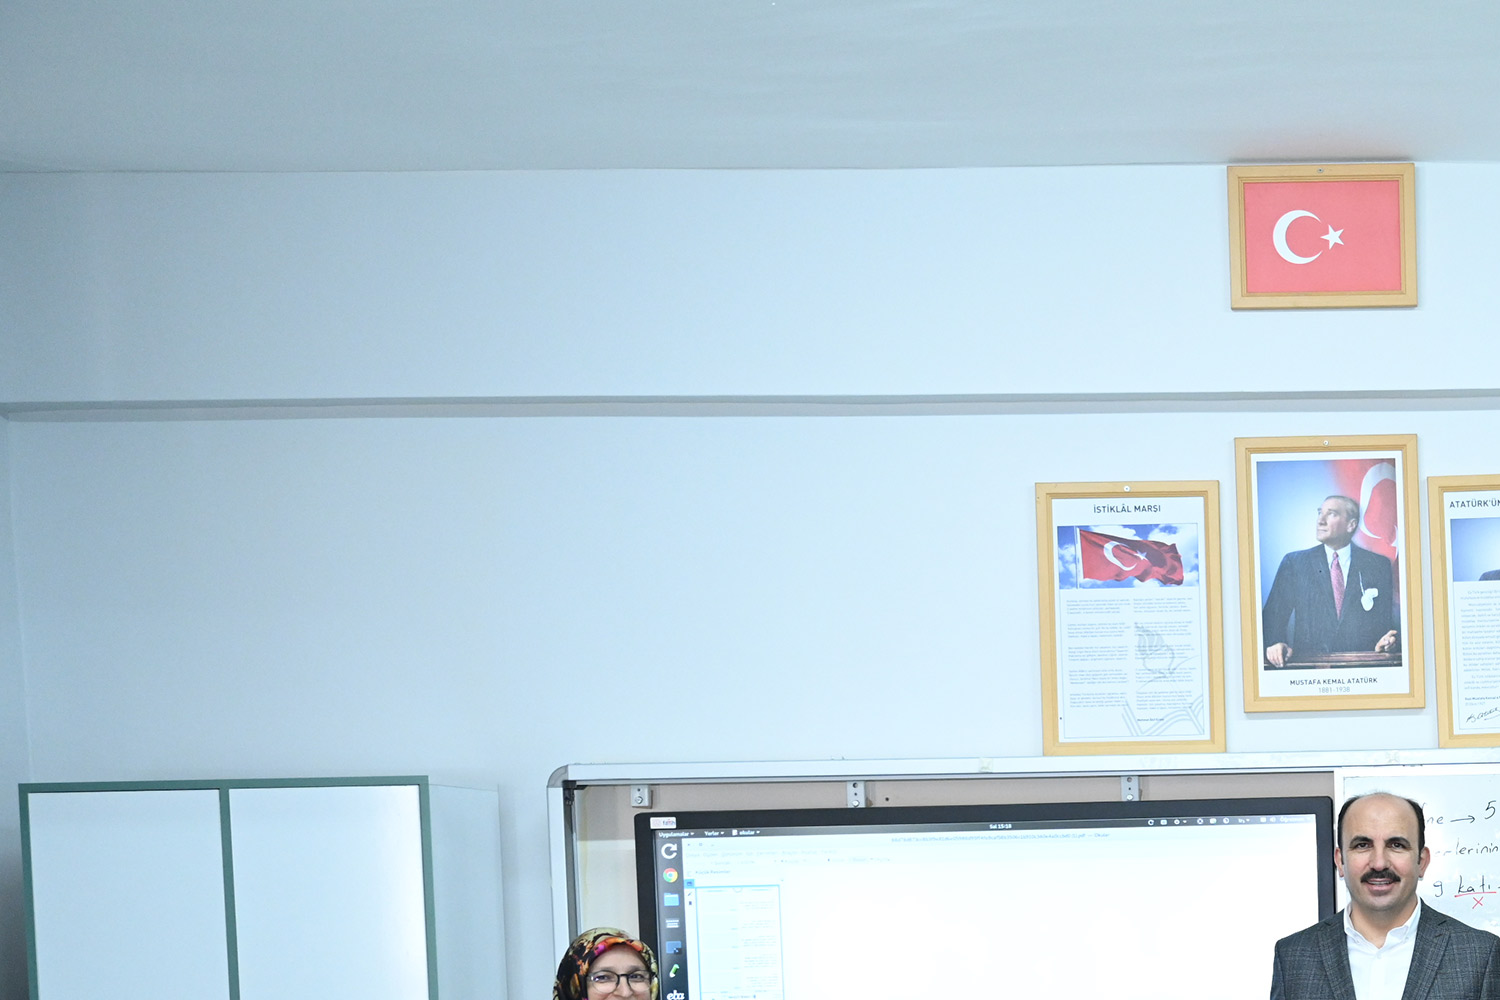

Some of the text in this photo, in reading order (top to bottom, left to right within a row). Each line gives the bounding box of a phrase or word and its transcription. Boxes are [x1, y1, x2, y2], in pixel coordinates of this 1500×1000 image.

[1093, 503, 1161, 514] İSTİKLÂL MARŞI
[1289, 678, 1322, 686] MUSTAFA
[1346, 676, 1378, 684] ATATÜRK
[1484, 800, 1497, 820] 5
[1457, 874, 1492, 894] katı
